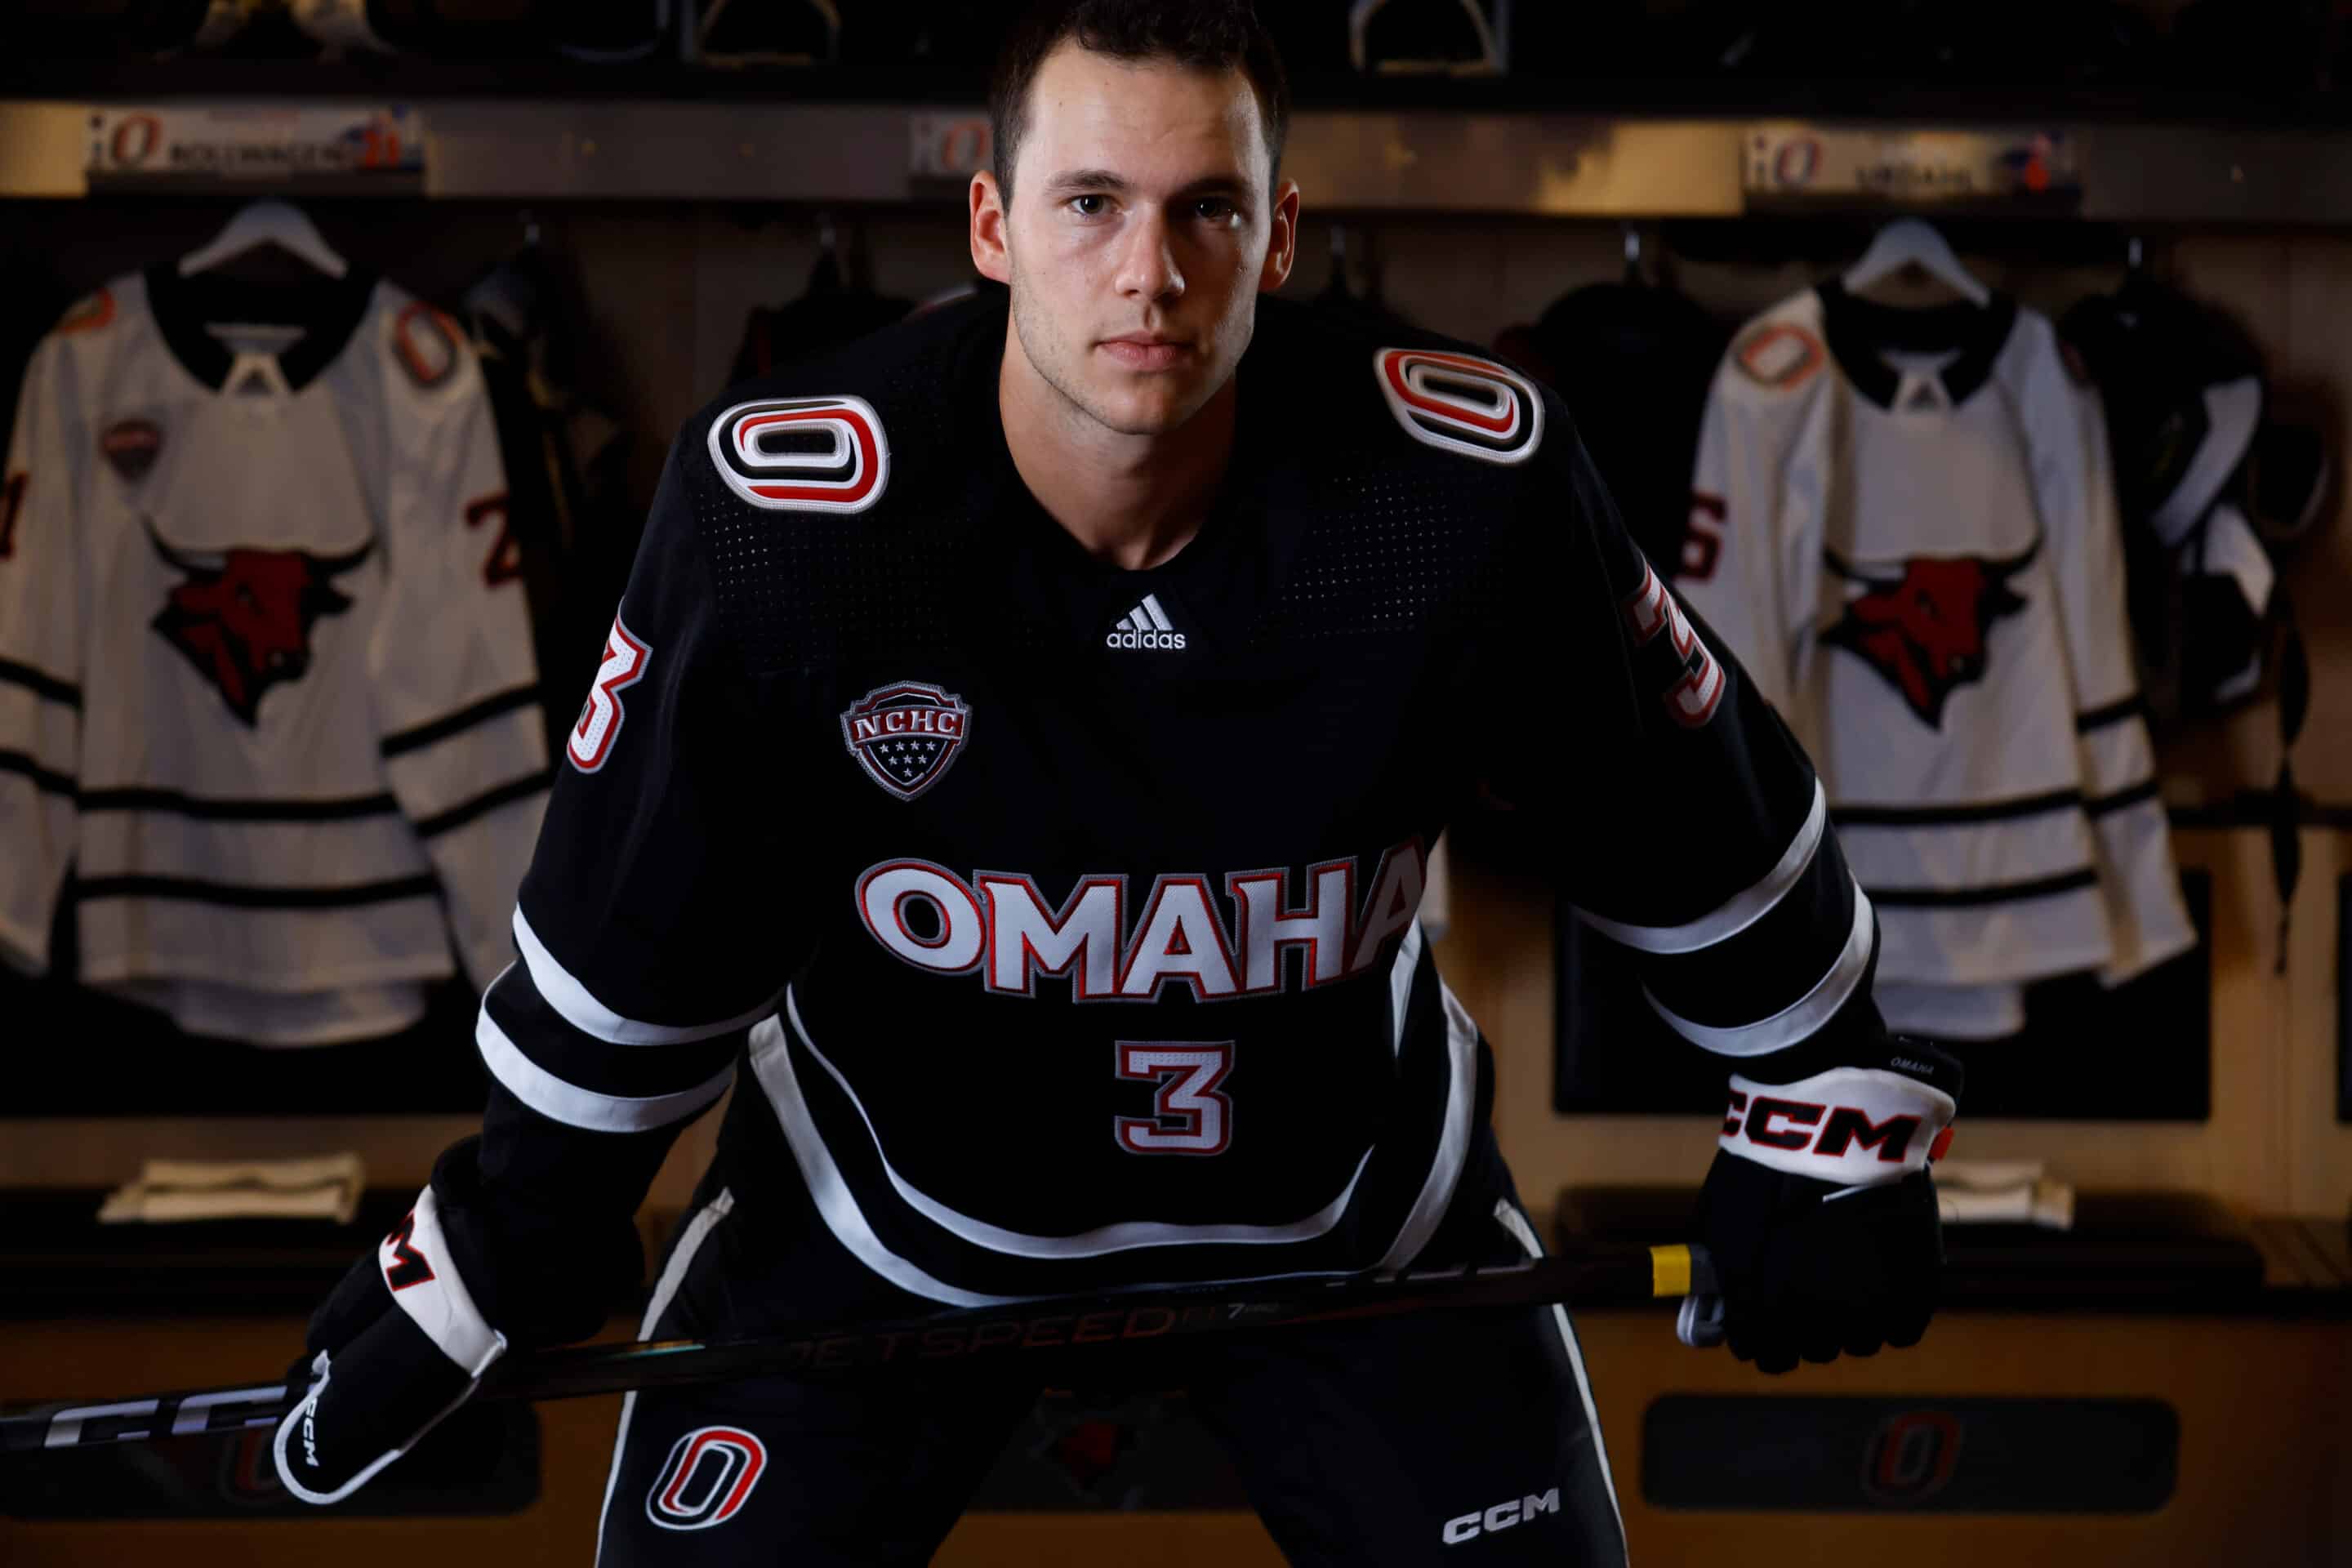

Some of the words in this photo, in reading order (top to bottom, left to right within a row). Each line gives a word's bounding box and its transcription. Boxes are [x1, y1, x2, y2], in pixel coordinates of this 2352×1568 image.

[1105, 627, 1187, 650] adidas
[854, 708, 961, 740] NCHC
[853, 834, 1427, 1004] OMAHA
[1113, 1039, 1236, 1158] 3
[1442, 1486, 1561, 1546] CCM
